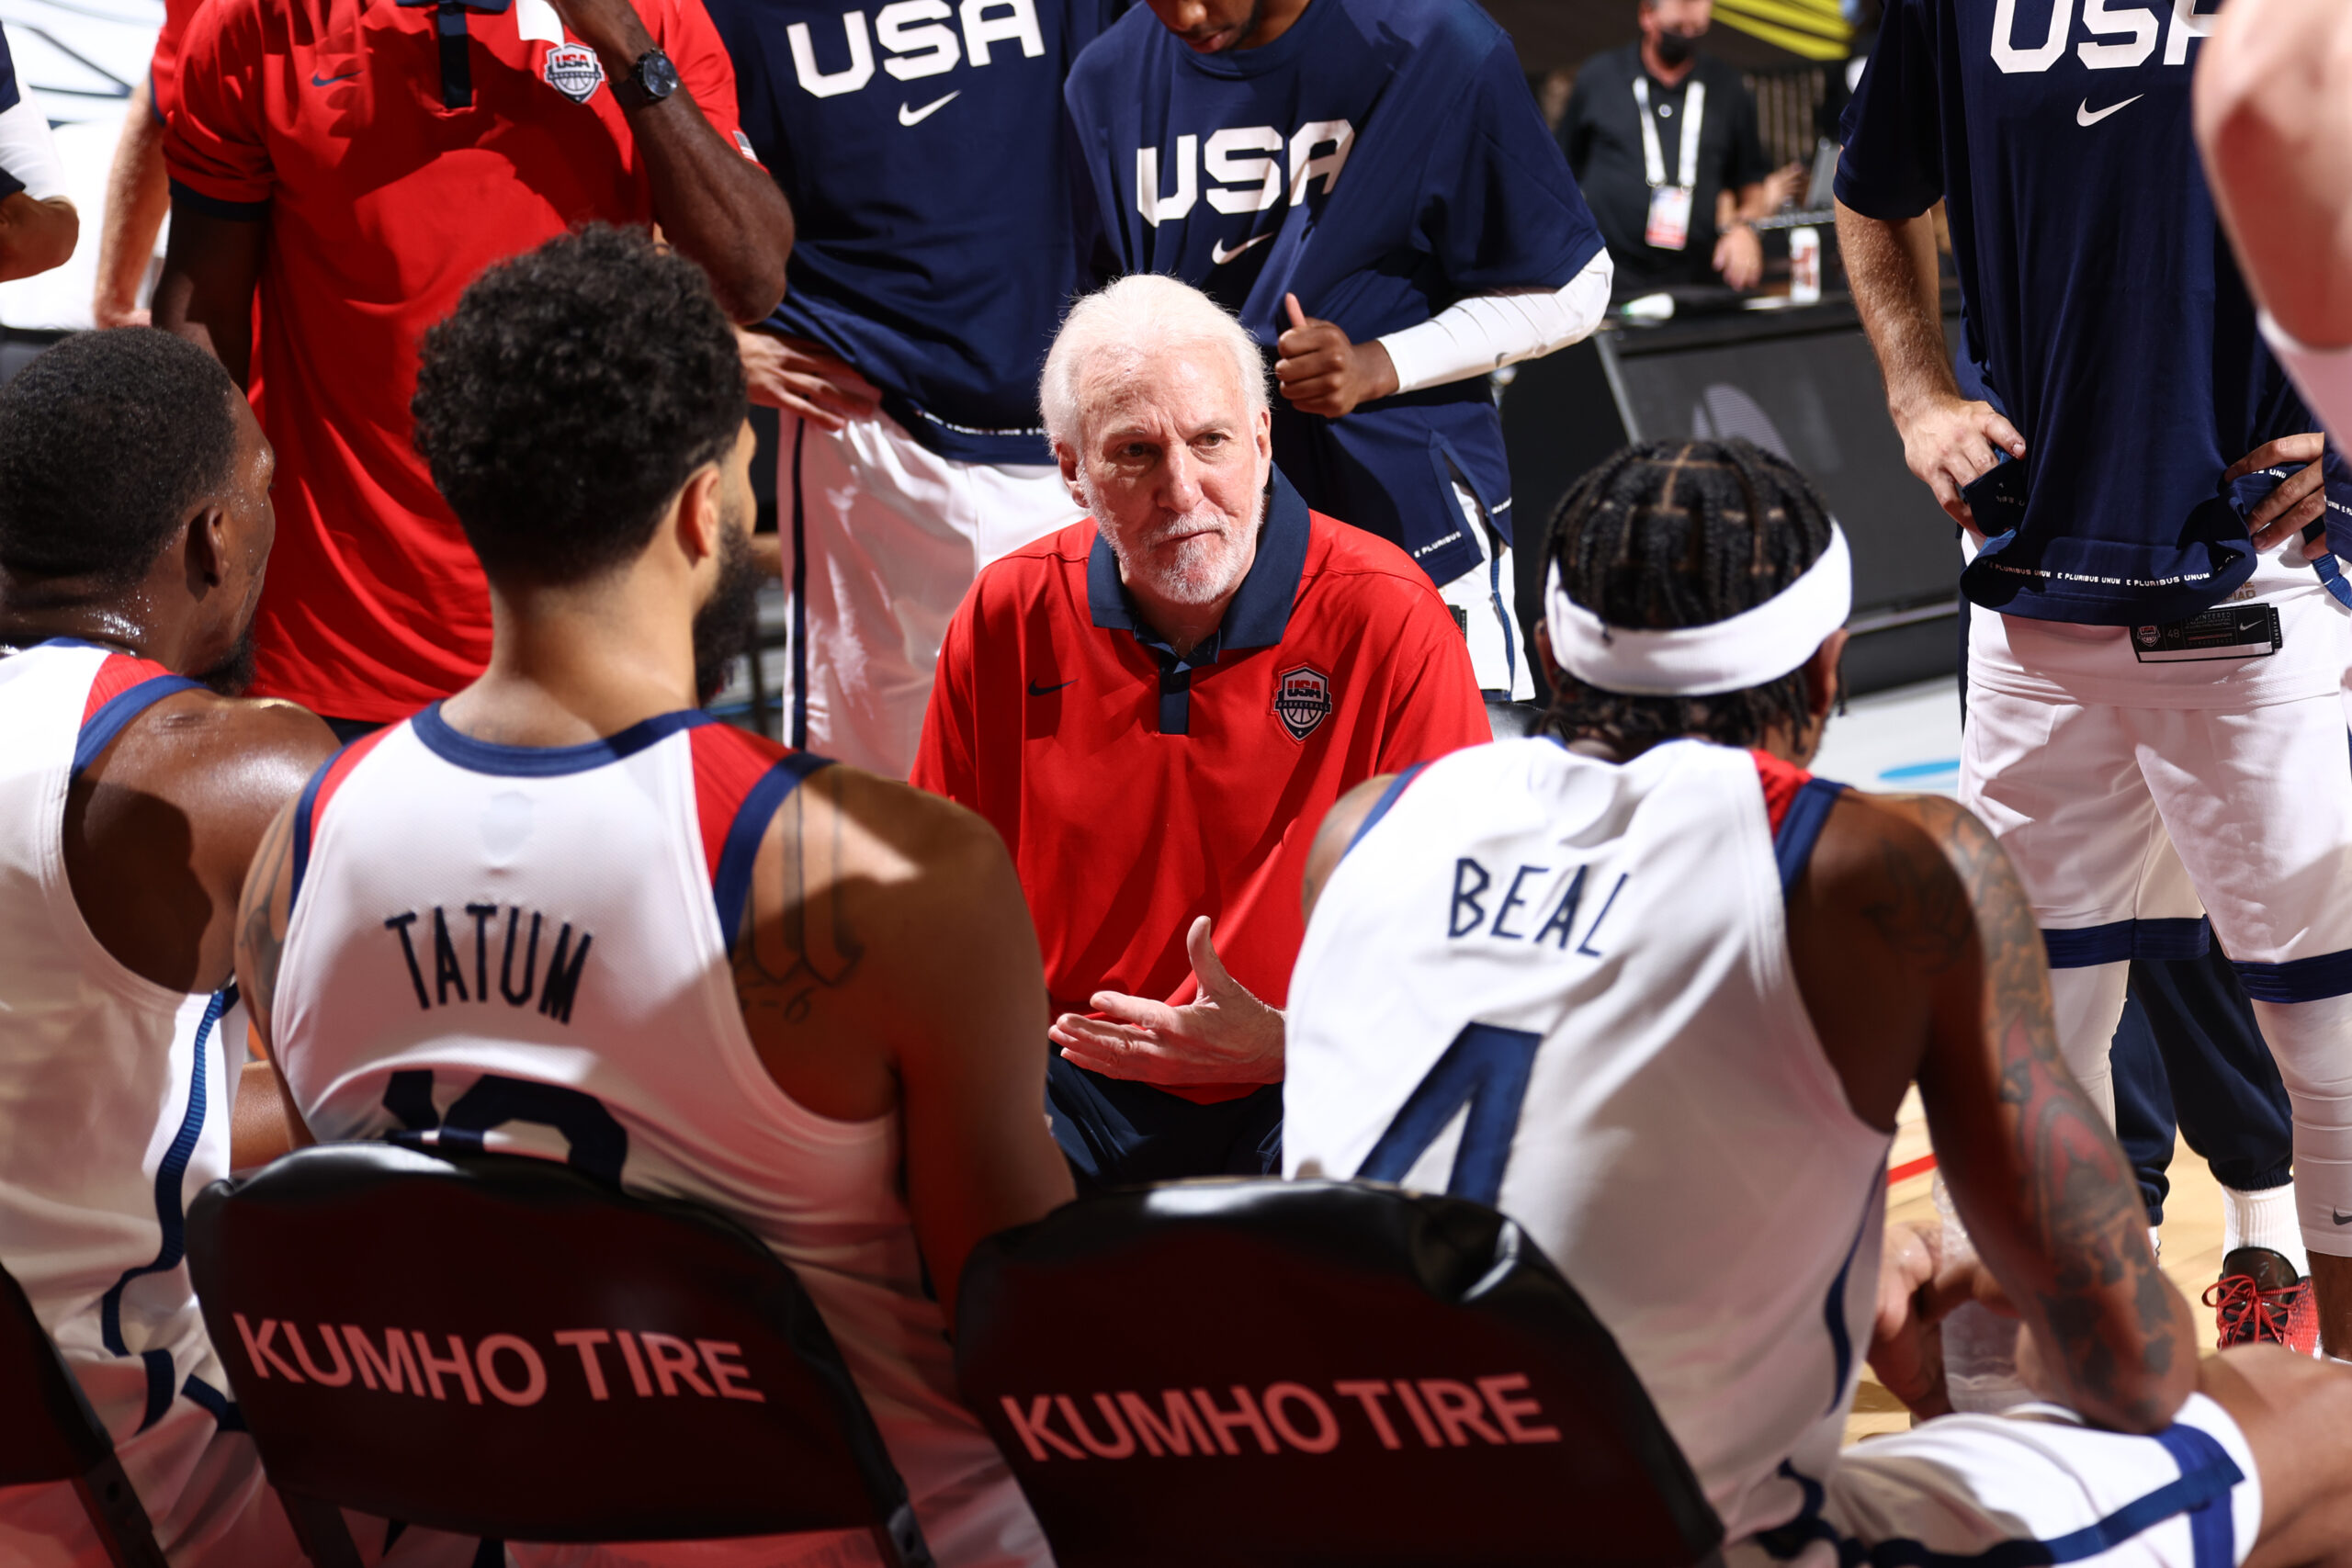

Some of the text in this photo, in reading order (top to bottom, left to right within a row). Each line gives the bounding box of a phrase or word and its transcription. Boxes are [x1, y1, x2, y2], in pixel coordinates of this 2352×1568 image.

[555, 53, 591, 69] USA
[786, 0, 1046, 98] USA
[1136, 118, 1355, 228] USA
[1421, 531, 1462, 555] PLURIBUS
[2064, 573, 2098, 583] PLURIBUS
[2101, 577, 2120, 585] UNUM
[2134, 576, 2180, 587] PLURIBUS
[2184, 572, 2211, 581] UNUM
[2167, 628, 2180, 639] 48
[1287, 680, 1322, 699] USA
[1448, 857, 1629, 958] BEAL
[384, 904, 593, 1025] TATUM
[232, 1314, 766, 1406] KUMHO TIRE
[1001, 1372, 1562, 1461] KUMHO TIRE
